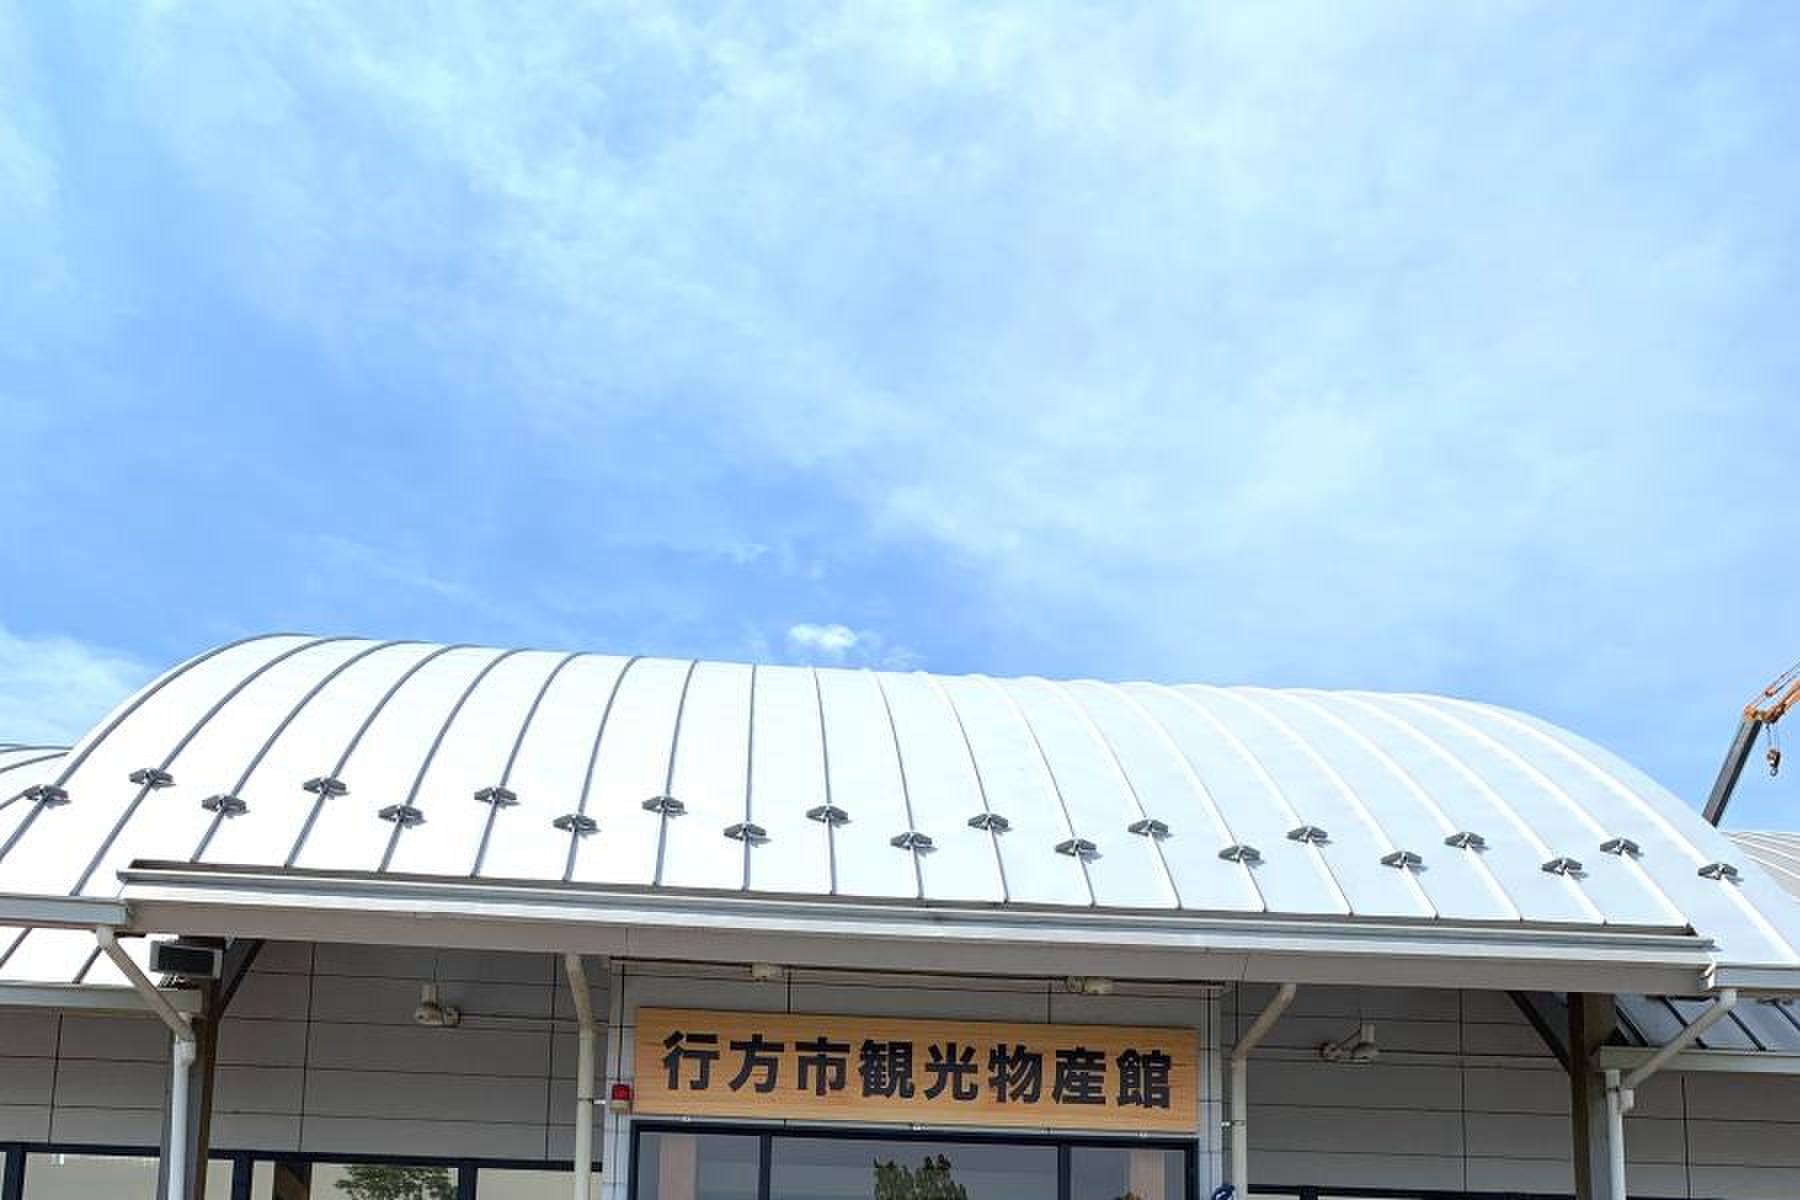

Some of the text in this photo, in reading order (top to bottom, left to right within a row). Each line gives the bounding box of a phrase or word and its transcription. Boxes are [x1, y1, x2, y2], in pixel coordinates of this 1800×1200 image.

[662, 1030, 1172, 1108] 行方市観光物産館
